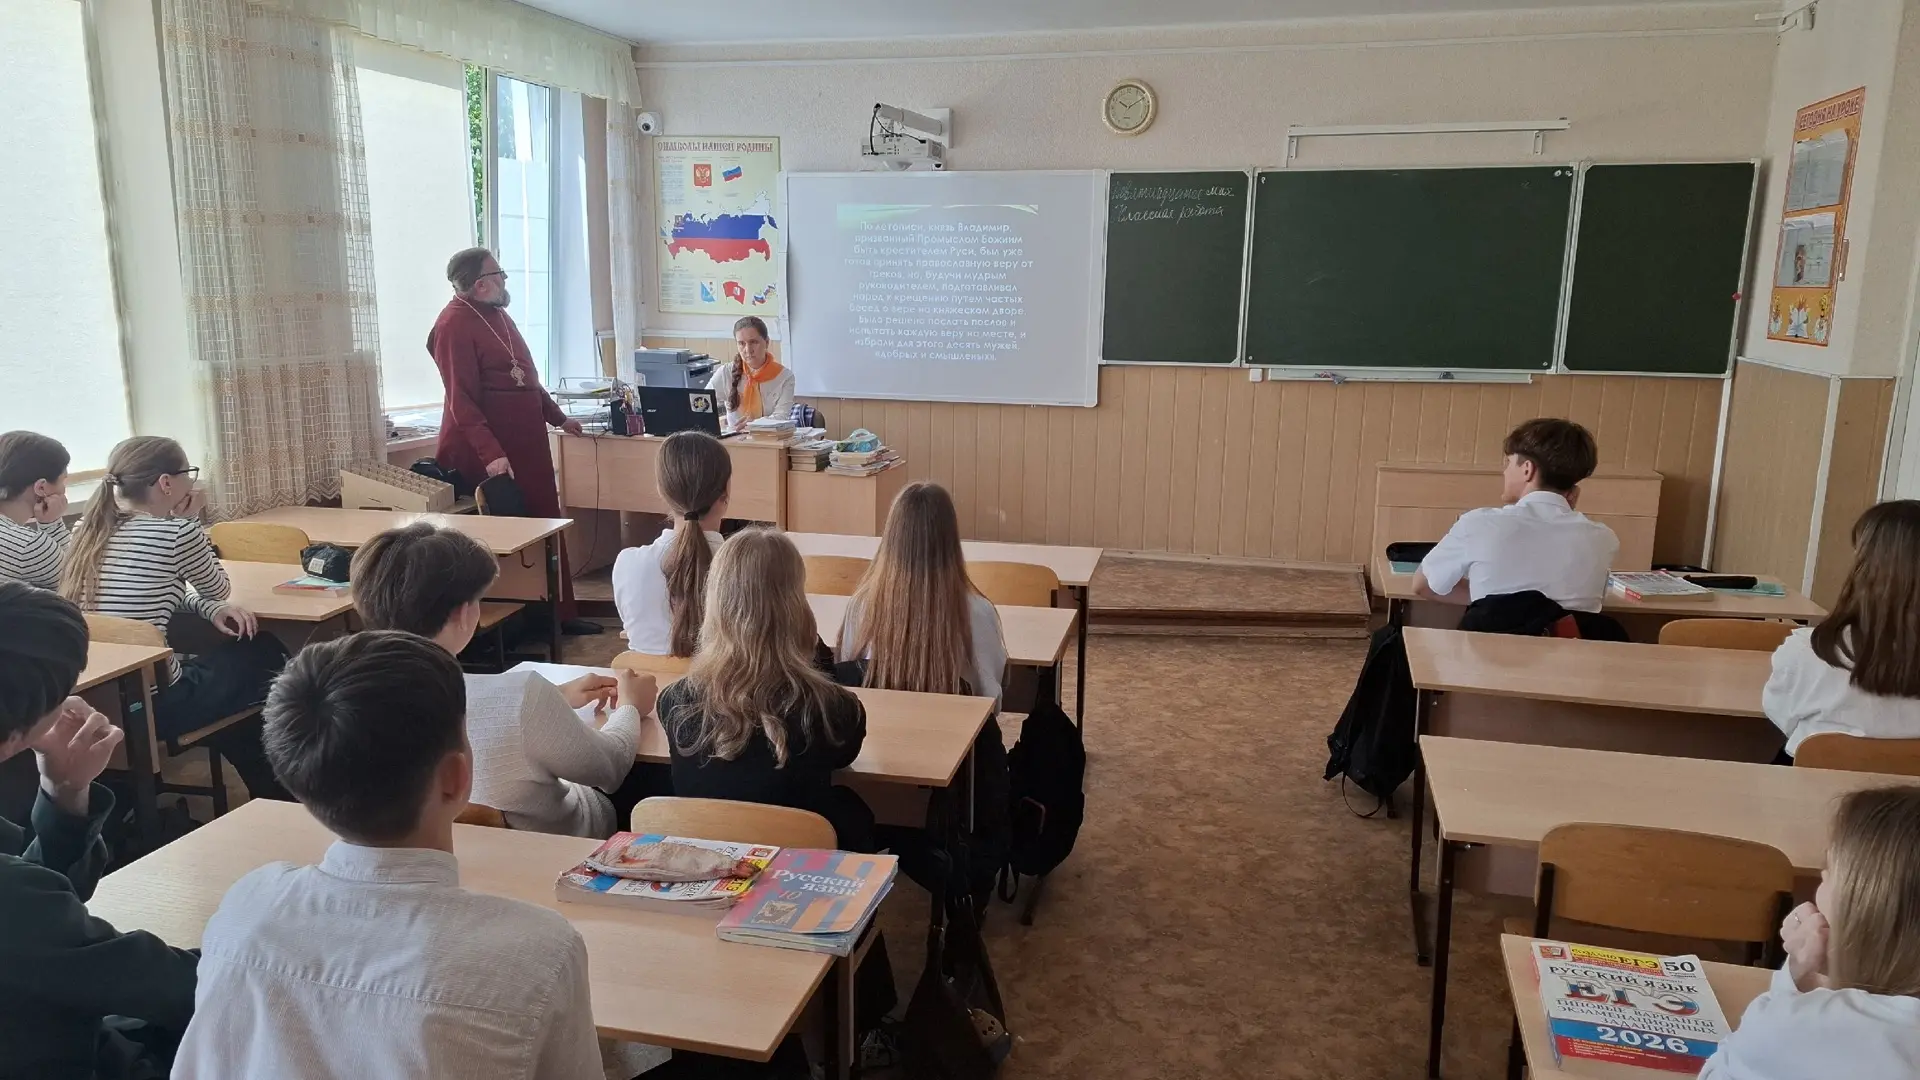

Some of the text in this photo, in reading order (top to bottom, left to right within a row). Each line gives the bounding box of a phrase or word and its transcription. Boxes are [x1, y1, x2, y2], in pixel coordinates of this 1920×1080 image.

[657, 141, 773, 154] СИМВОЛЫ НАШЕЙ РОДИНЫ
[1206, 186, 1235, 197] мая
[1115, 204, 1224, 225] Классная работа
[860, 221, 1012, 233] По летописи, князь Владимир,
[855, 233, 1023, 245] призванный Промыслом Божиим
[853, 244, 1023, 258] быть крестителем Руси, был уже
[844, 258, 1033, 270] готов принять православную веру от
[869, 270, 905, 279] греков,
[925, 270, 961, 280] будучи
[964, 272, 1007, 281] мудрым
[859, 282, 1018, 292] руководителем, подготавливал
[853, 293, 884, 302] народ
[894, 294, 949, 303] крещению
[952, 295, 982, 304] путем
[849, 302, 880, 312] бесед
[891, 305, 916, 314] вере
[859, 315, 883, 324] Было
[885, 317, 925, 326] решено
[928, 318, 969, 326] послать
[849, 326, 895, 336] испытать
[898, 328, 938, 338] каждую
[941, 330, 964, 339] веру
[982, 331, 1017, 340] месте,
[854, 336, 1020, 351] избрали для этого десять мужей,
[771, 869, 866, 888] Русский
[779, 891, 802, 900] 10
[800, 882, 861, 897] язык
[1617, 956, 1659, 969] ЕГЭ
[1664, 961, 1696, 972] 50
[1549, 965, 1638, 985] РУССКИЙ
[1644, 980, 1698, 993] ЯЗЫК
[1560, 976, 1700, 1016] ЕГЭ
[1555, 999, 1714, 1028] ТИПОВЫЕ ВАРИАНТЫ
[1557, 1005, 1717, 1035] ЭКЗАМЕНАЦИОННЫХ
[1600, 1016, 1677, 1035] ЗАДАНИЙ
[1597, 1027, 1689, 1054] 2026
